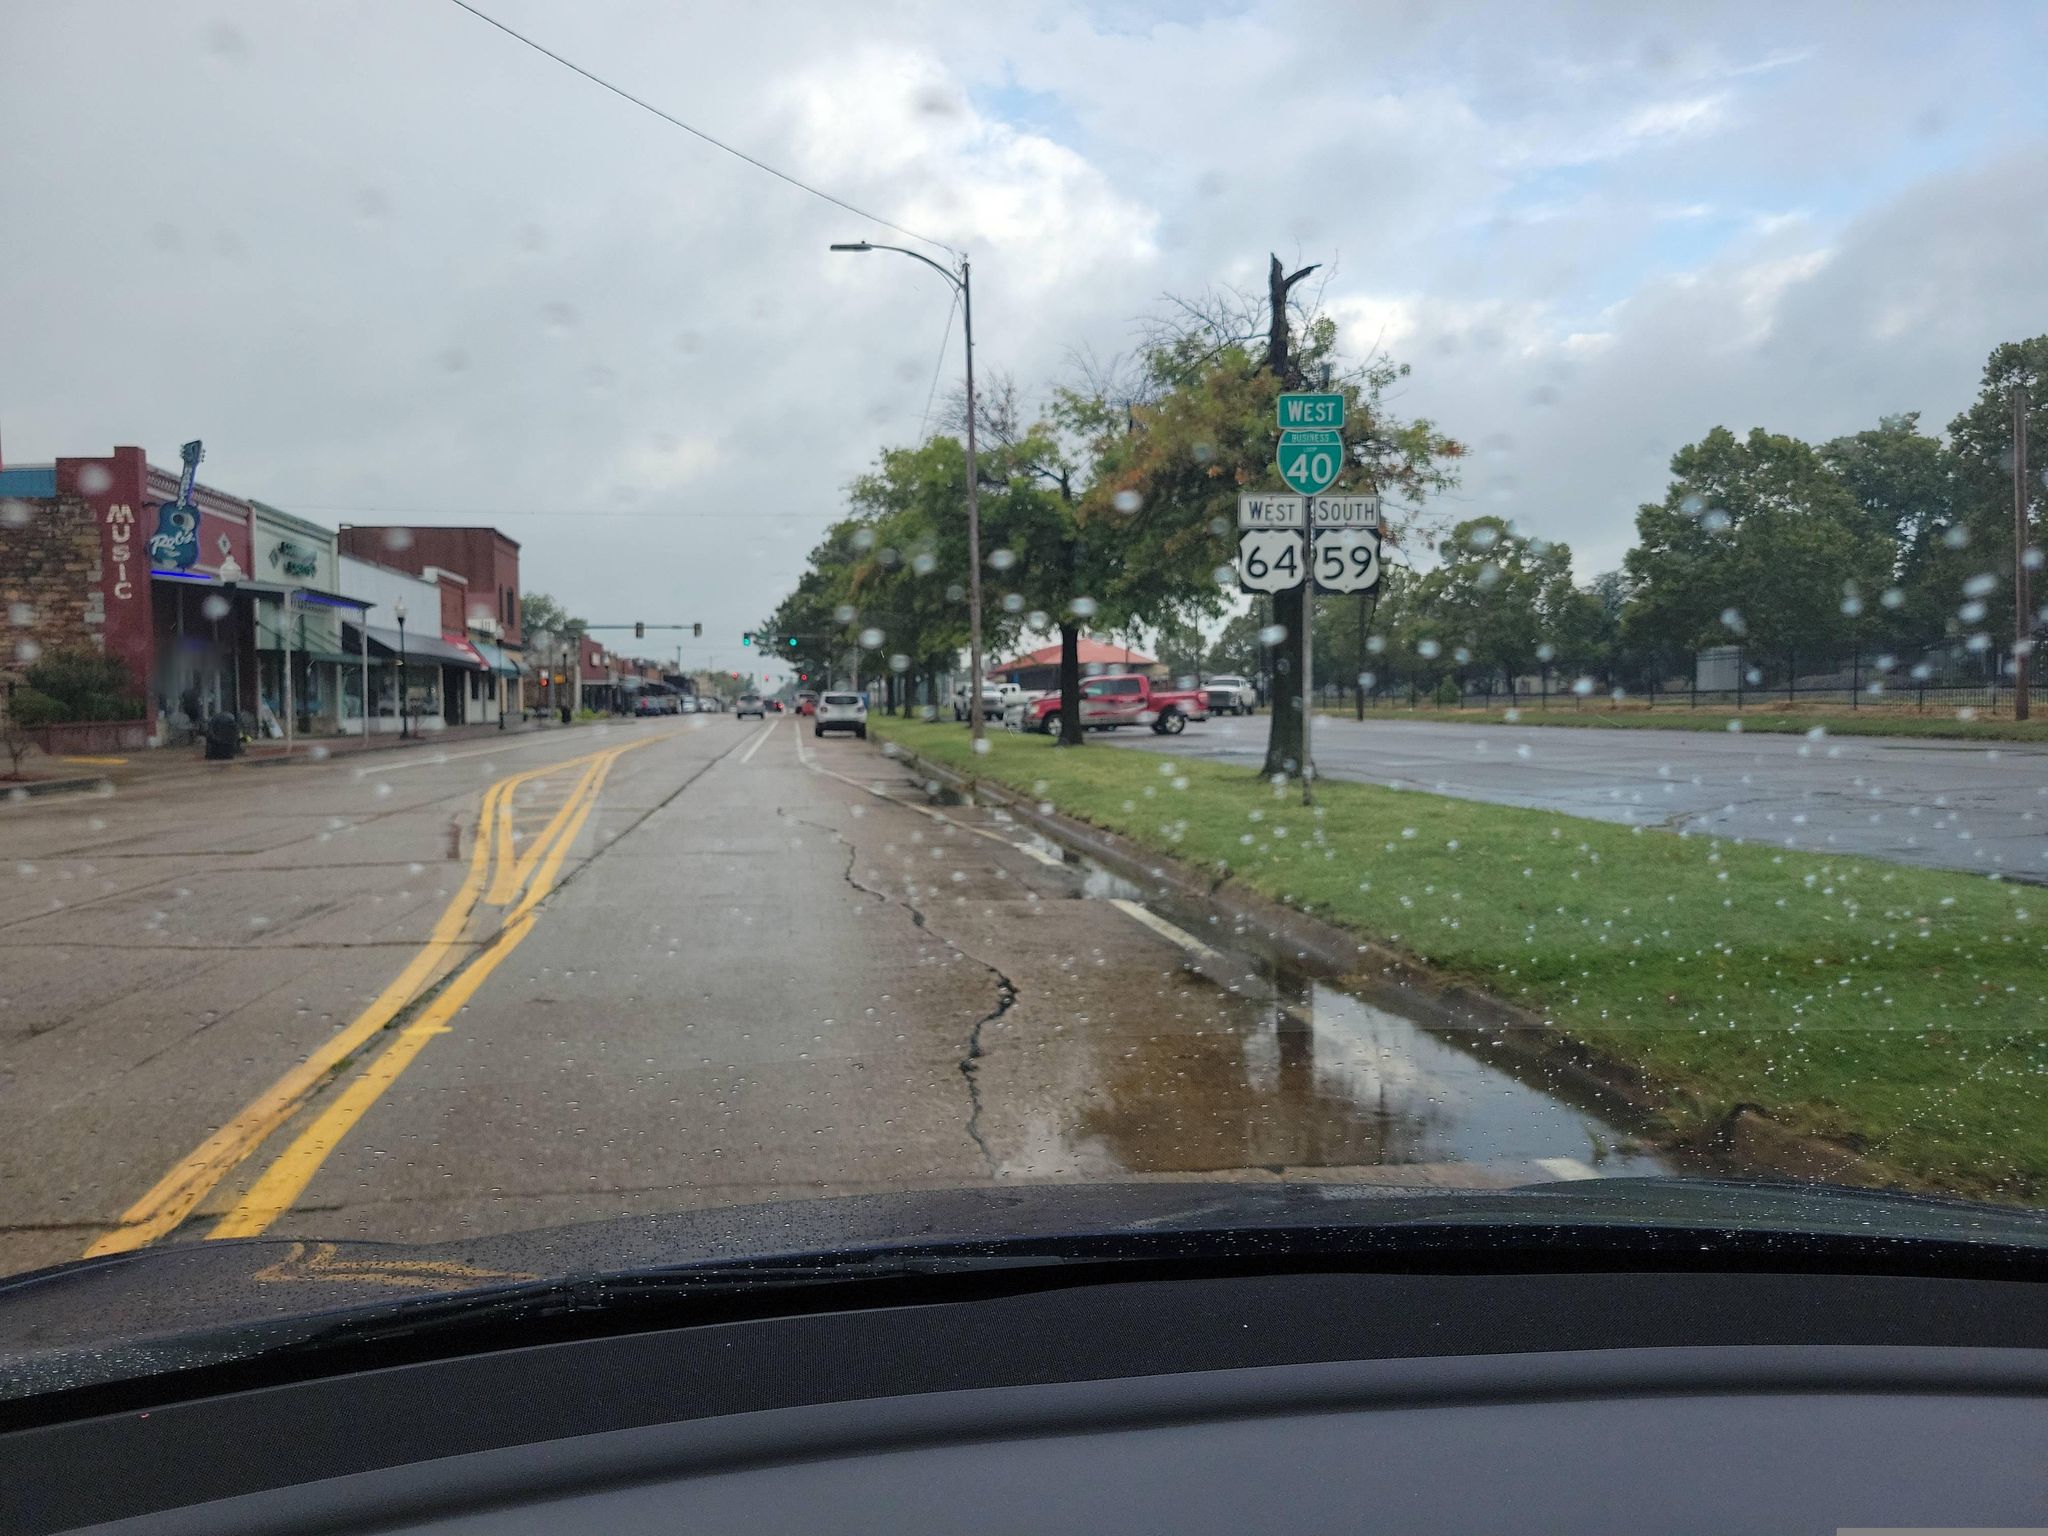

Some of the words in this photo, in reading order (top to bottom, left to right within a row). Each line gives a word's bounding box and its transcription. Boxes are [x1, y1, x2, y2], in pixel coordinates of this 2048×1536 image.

[1288, 400, 1335, 422] WEST
[1291, 434, 1329, 442] BUSINESS
[1287, 453, 1332, 484] 40
[1249, 501, 1295, 521] WEST
[1319, 500, 1374, 521] SOUTH
[106, 504, 135, 600] MUSIC
[1248, 545, 1297, 579] 64
[1323, 546, 1372, 580] 59
